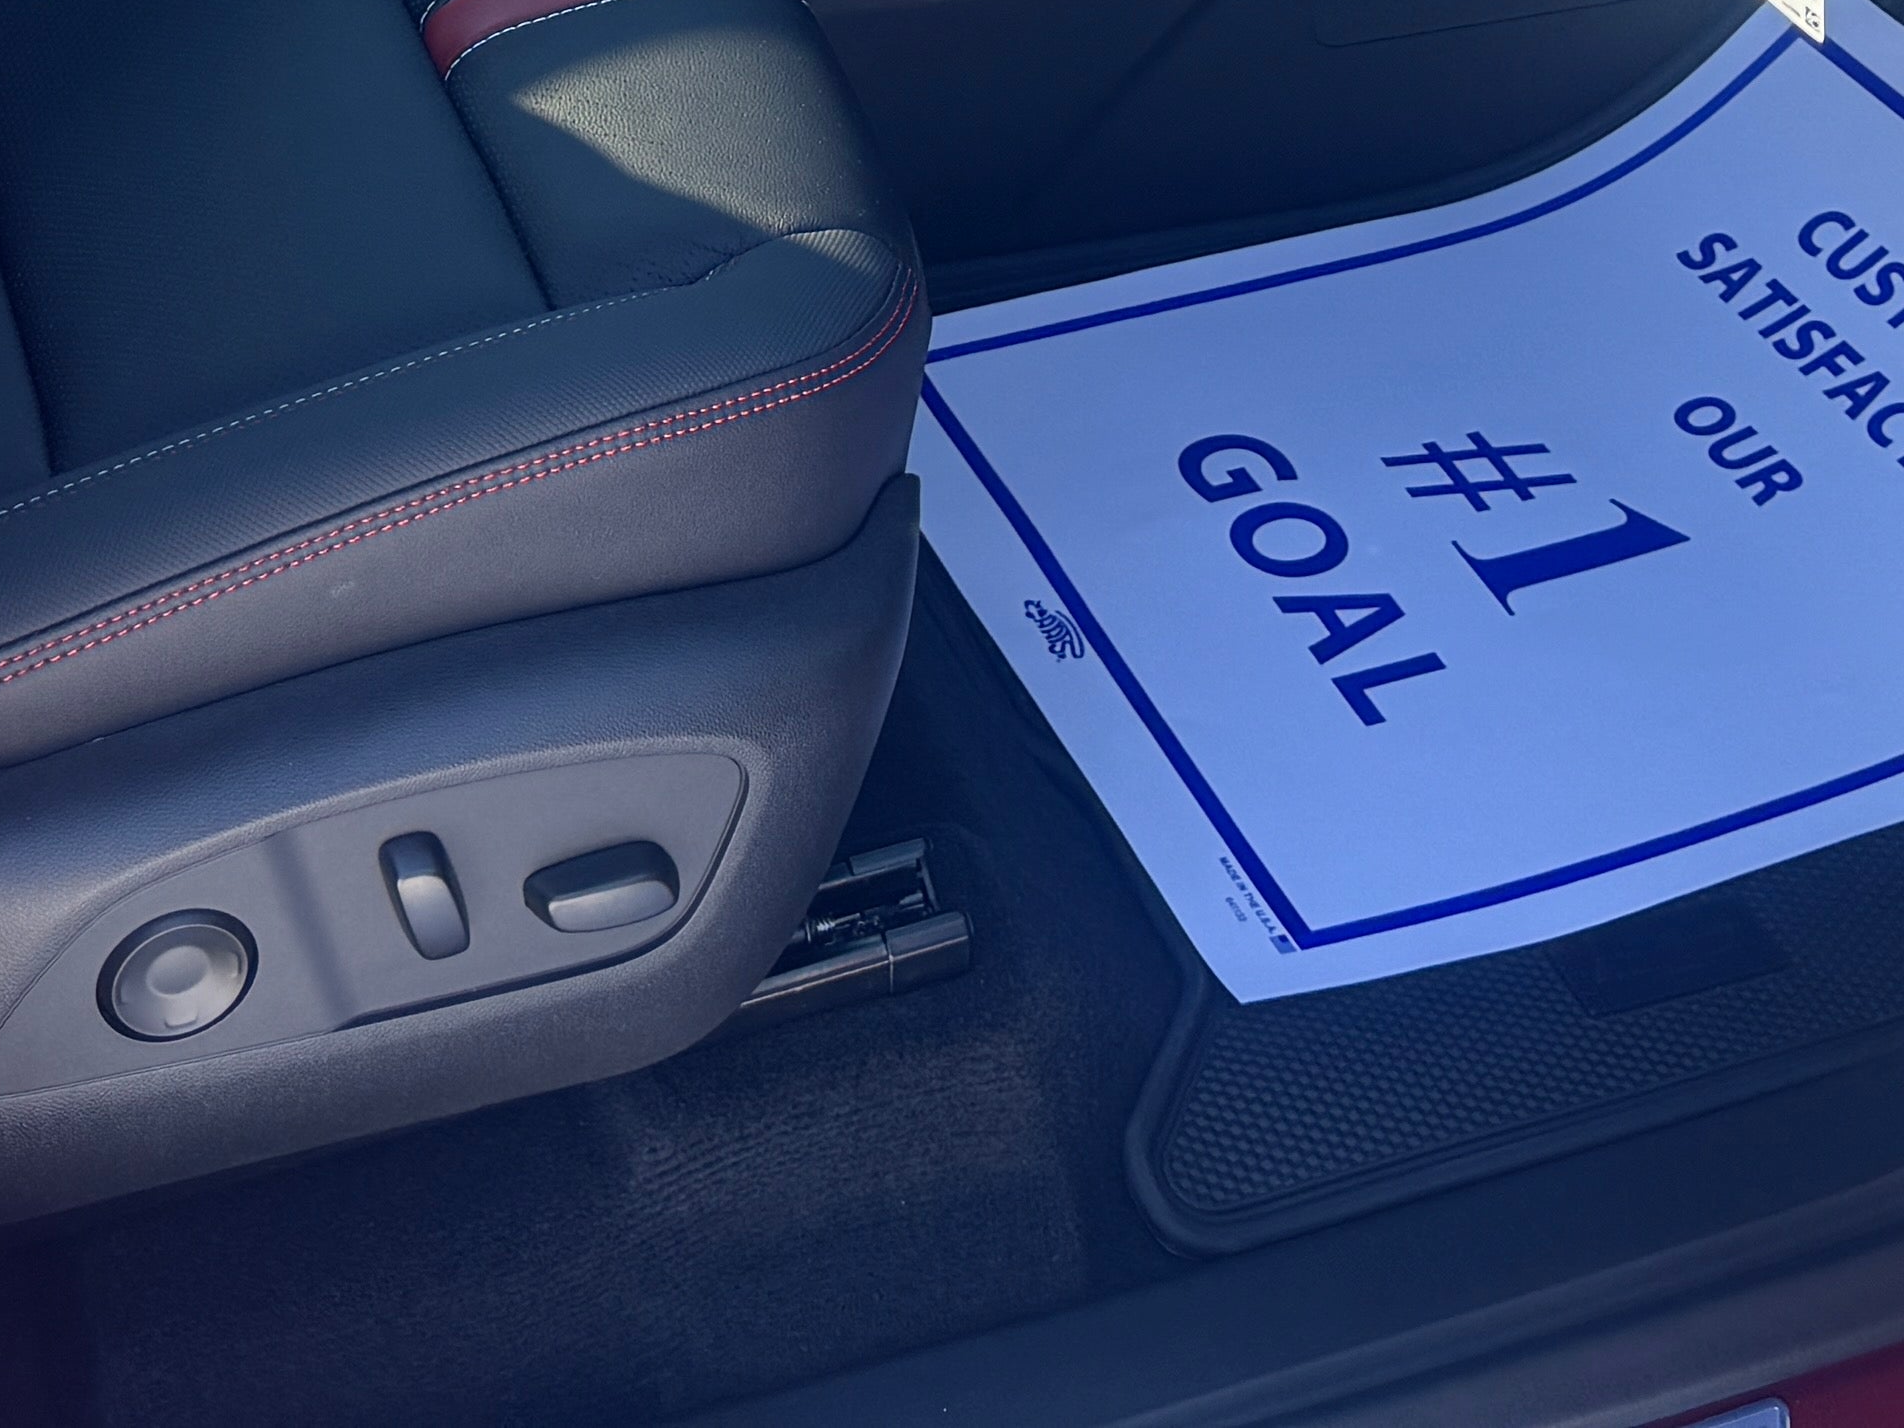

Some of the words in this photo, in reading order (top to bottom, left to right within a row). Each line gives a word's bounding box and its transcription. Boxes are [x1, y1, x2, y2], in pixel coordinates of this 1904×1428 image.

[1381, 432, 1690, 616] #1
[1674, 397, 1802, 506] OUR
[1178, 435, 1446, 726] GOAL
[1219, 857, 1241, 881] MADE
[1244, 892, 1261, 908] THE
